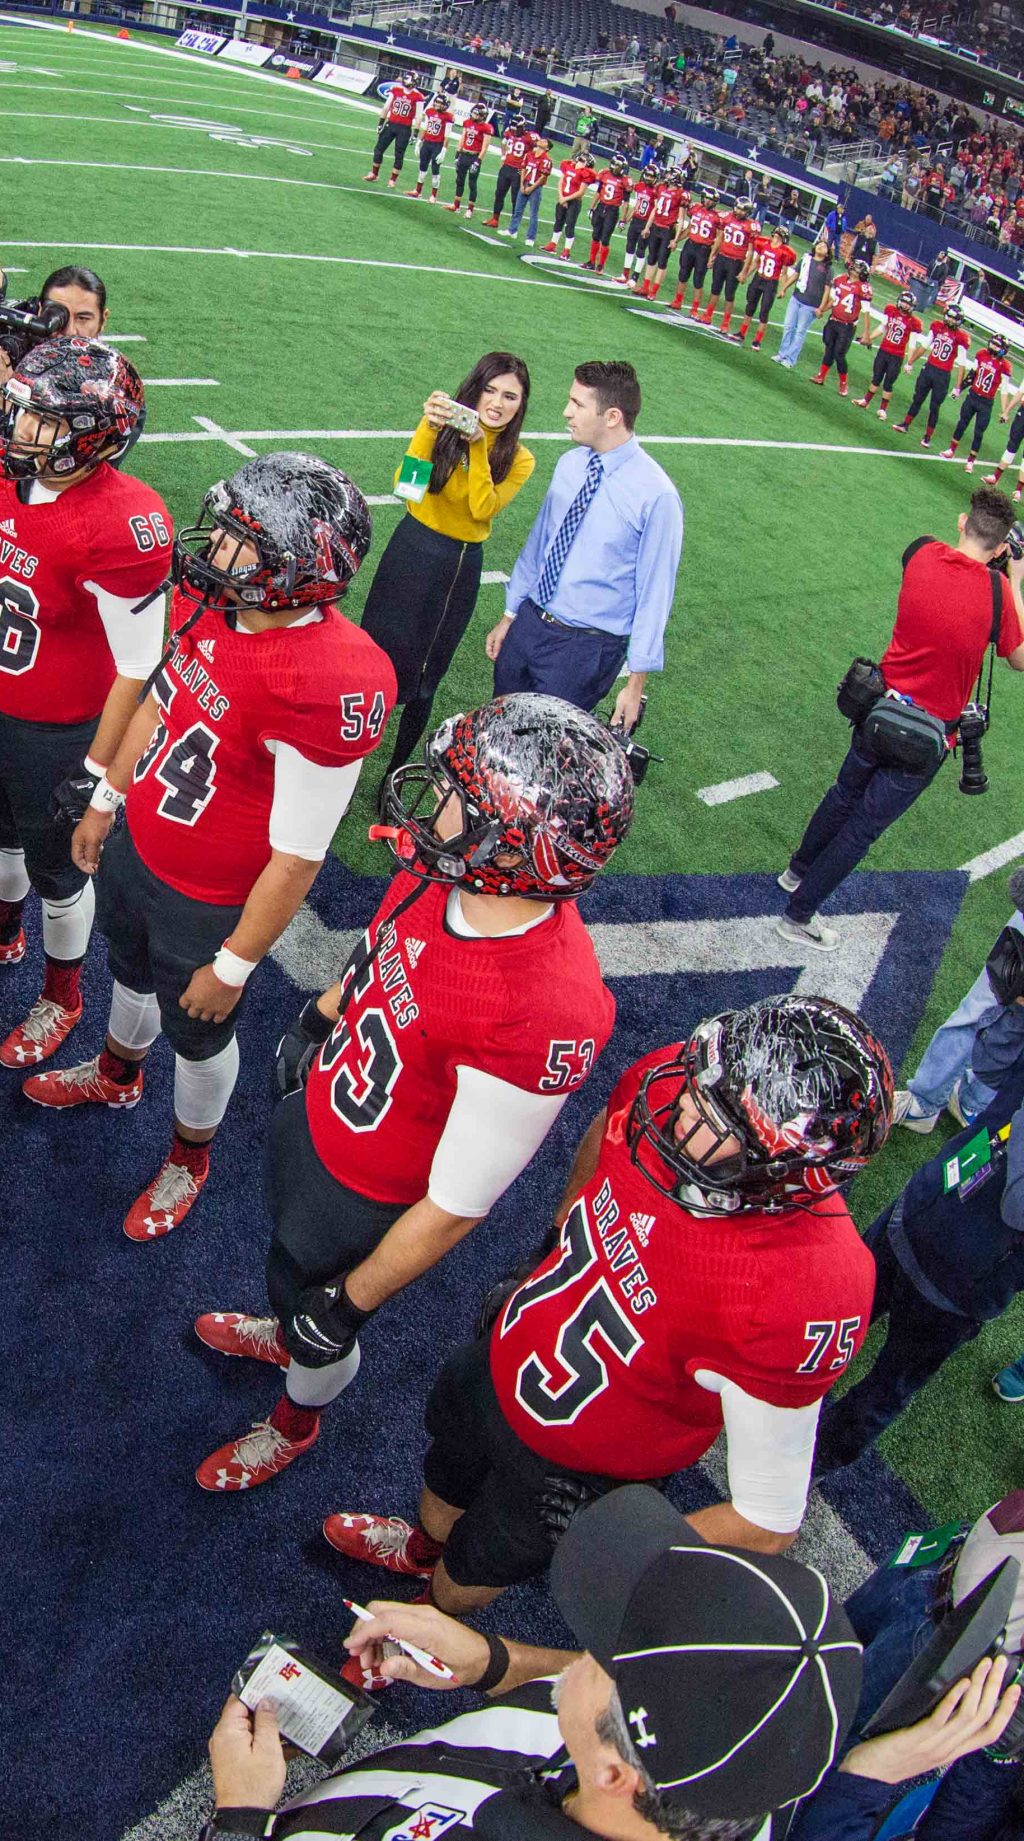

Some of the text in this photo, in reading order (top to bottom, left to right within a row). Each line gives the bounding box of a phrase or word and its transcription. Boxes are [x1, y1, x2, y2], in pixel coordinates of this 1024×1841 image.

[603, 183, 616, 201] 9
[723, 225, 745, 246] 60
[975, 366, 996, 393] 14
[411, 470, 418, 485] 1
[128, 511, 170, 553] 66
[340, 691, 386, 741] 54
[538, 1038, 595, 1091] 53
[961, 1152, 976, 1168] 1
[592, 1177, 657, 1315] BRAVES
[500, 1196, 645, 1427] 75
[796, 1315, 861, 1374] 75
